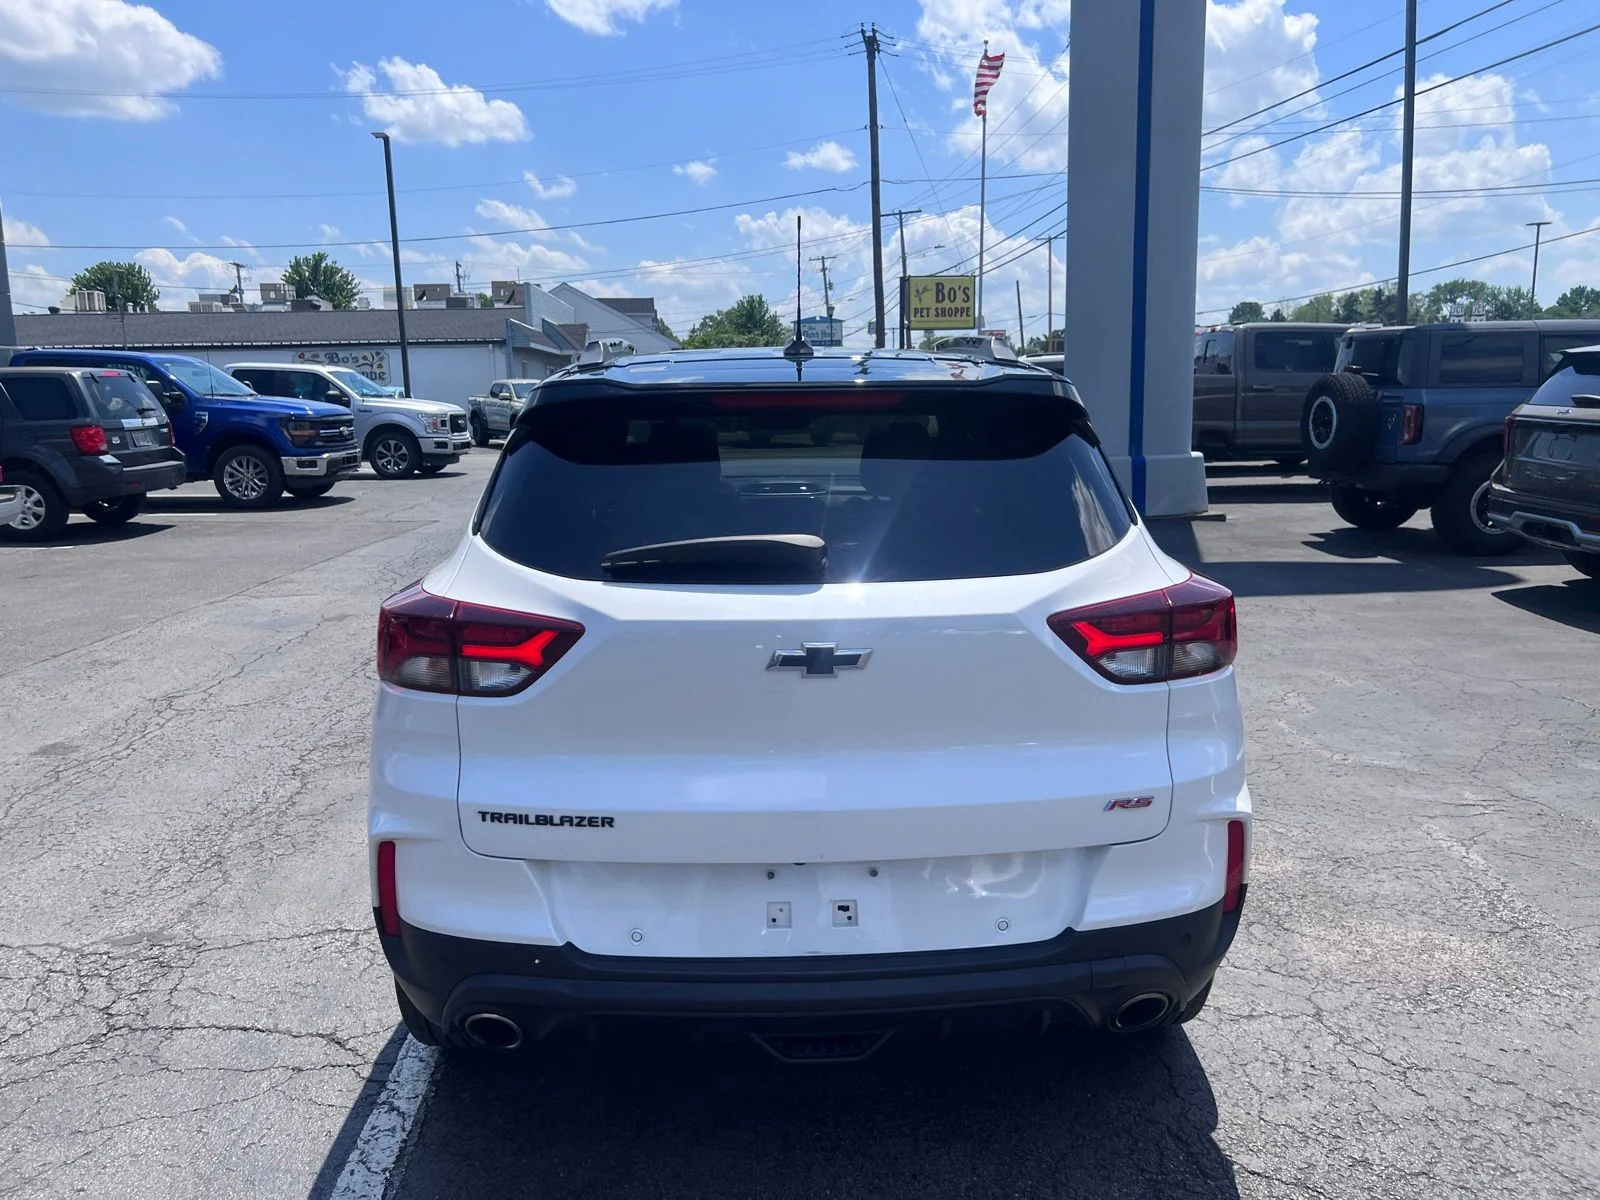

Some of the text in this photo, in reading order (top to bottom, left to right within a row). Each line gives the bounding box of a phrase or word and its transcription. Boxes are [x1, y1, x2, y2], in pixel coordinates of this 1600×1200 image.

[935, 282, 970, 303] Bo's
[914, 307, 971, 318] PET SHOPPE
[325, 352, 359, 363] Bo's
[1103, 796, 1154, 811] RS
[478, 811, 615, 828] TRAILBLAZER
